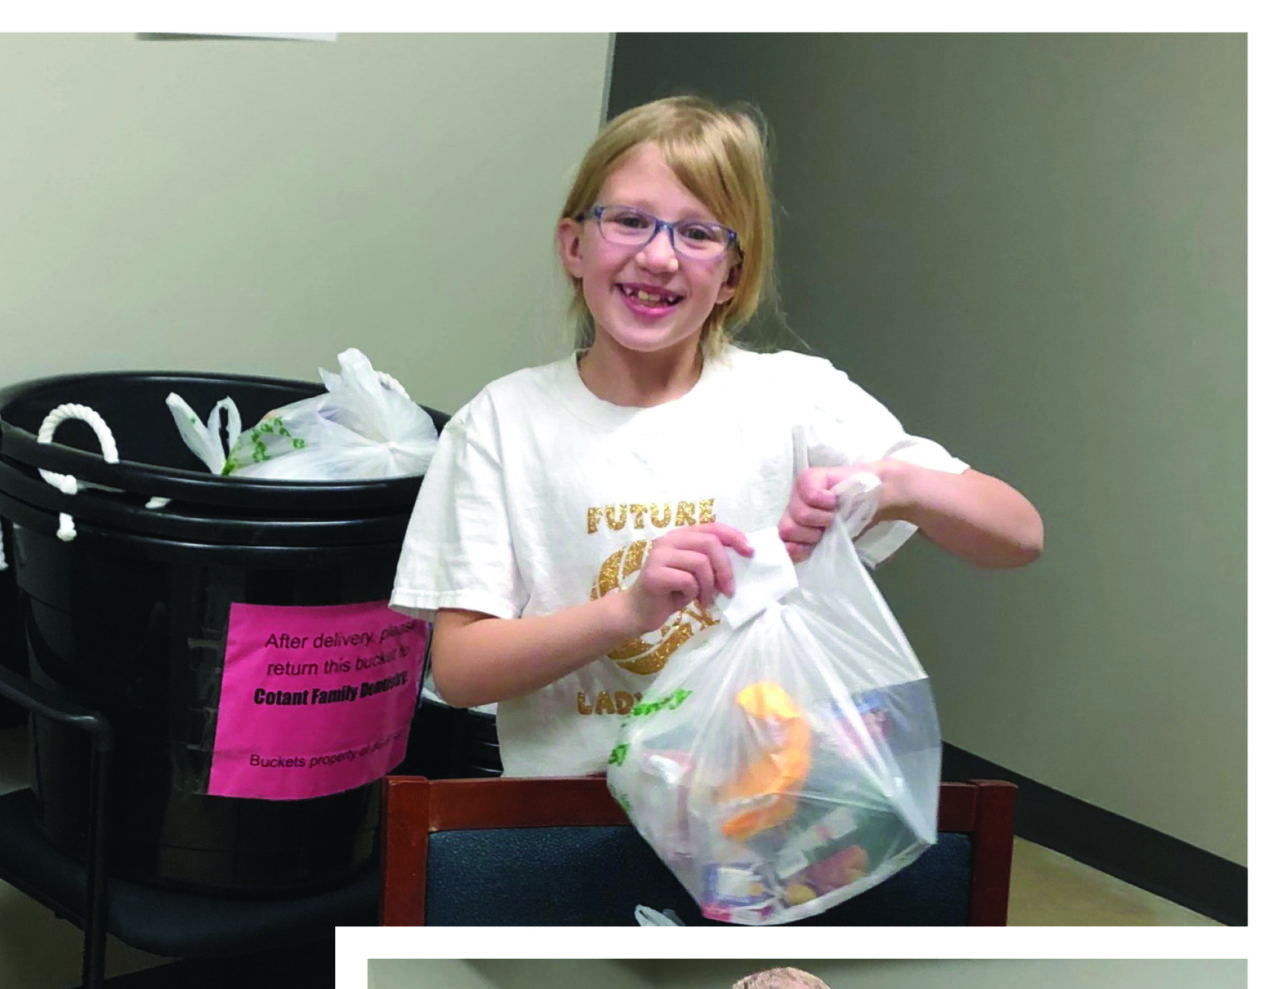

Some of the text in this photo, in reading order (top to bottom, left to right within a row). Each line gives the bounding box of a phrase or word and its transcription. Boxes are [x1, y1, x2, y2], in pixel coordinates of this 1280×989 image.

[587, 498, 716, 534] FUTURE
[264, 633, 308, 649] After
[267, 645, 410, 676] return this bucket to
[254, 688, 309, 705] Cotant
[311, 684, 358, 704] Family
[577, 691, 643, 715] LAD
[250, 754, 306, 767] Buckets
[309, 750, 356, 768] property
